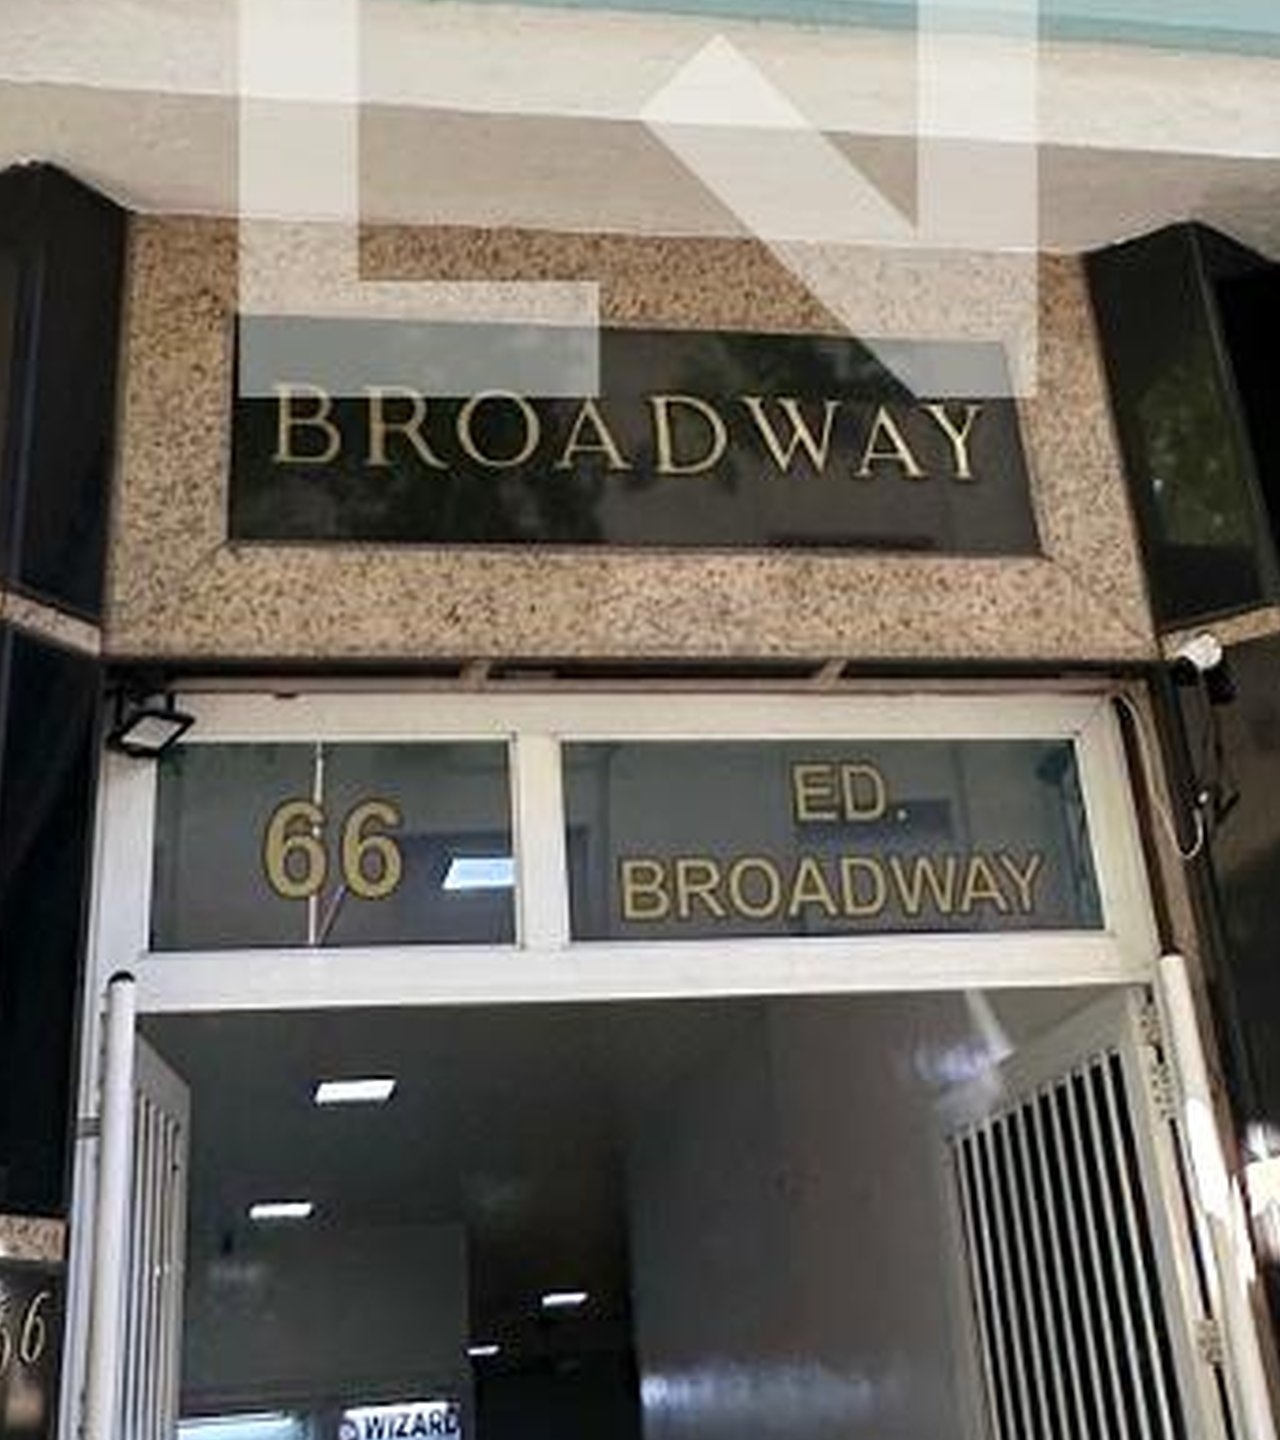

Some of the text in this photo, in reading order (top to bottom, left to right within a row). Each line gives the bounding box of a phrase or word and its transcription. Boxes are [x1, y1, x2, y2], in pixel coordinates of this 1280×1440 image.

[272, 382, 983, 482] BROADWAY
[790, 761, 909, 824] ED.
[262, 799, 404, 903] 66
[618, 851, 1042, 920] BROADWAY
[365, 1410, 457, 1440] WIZARD
